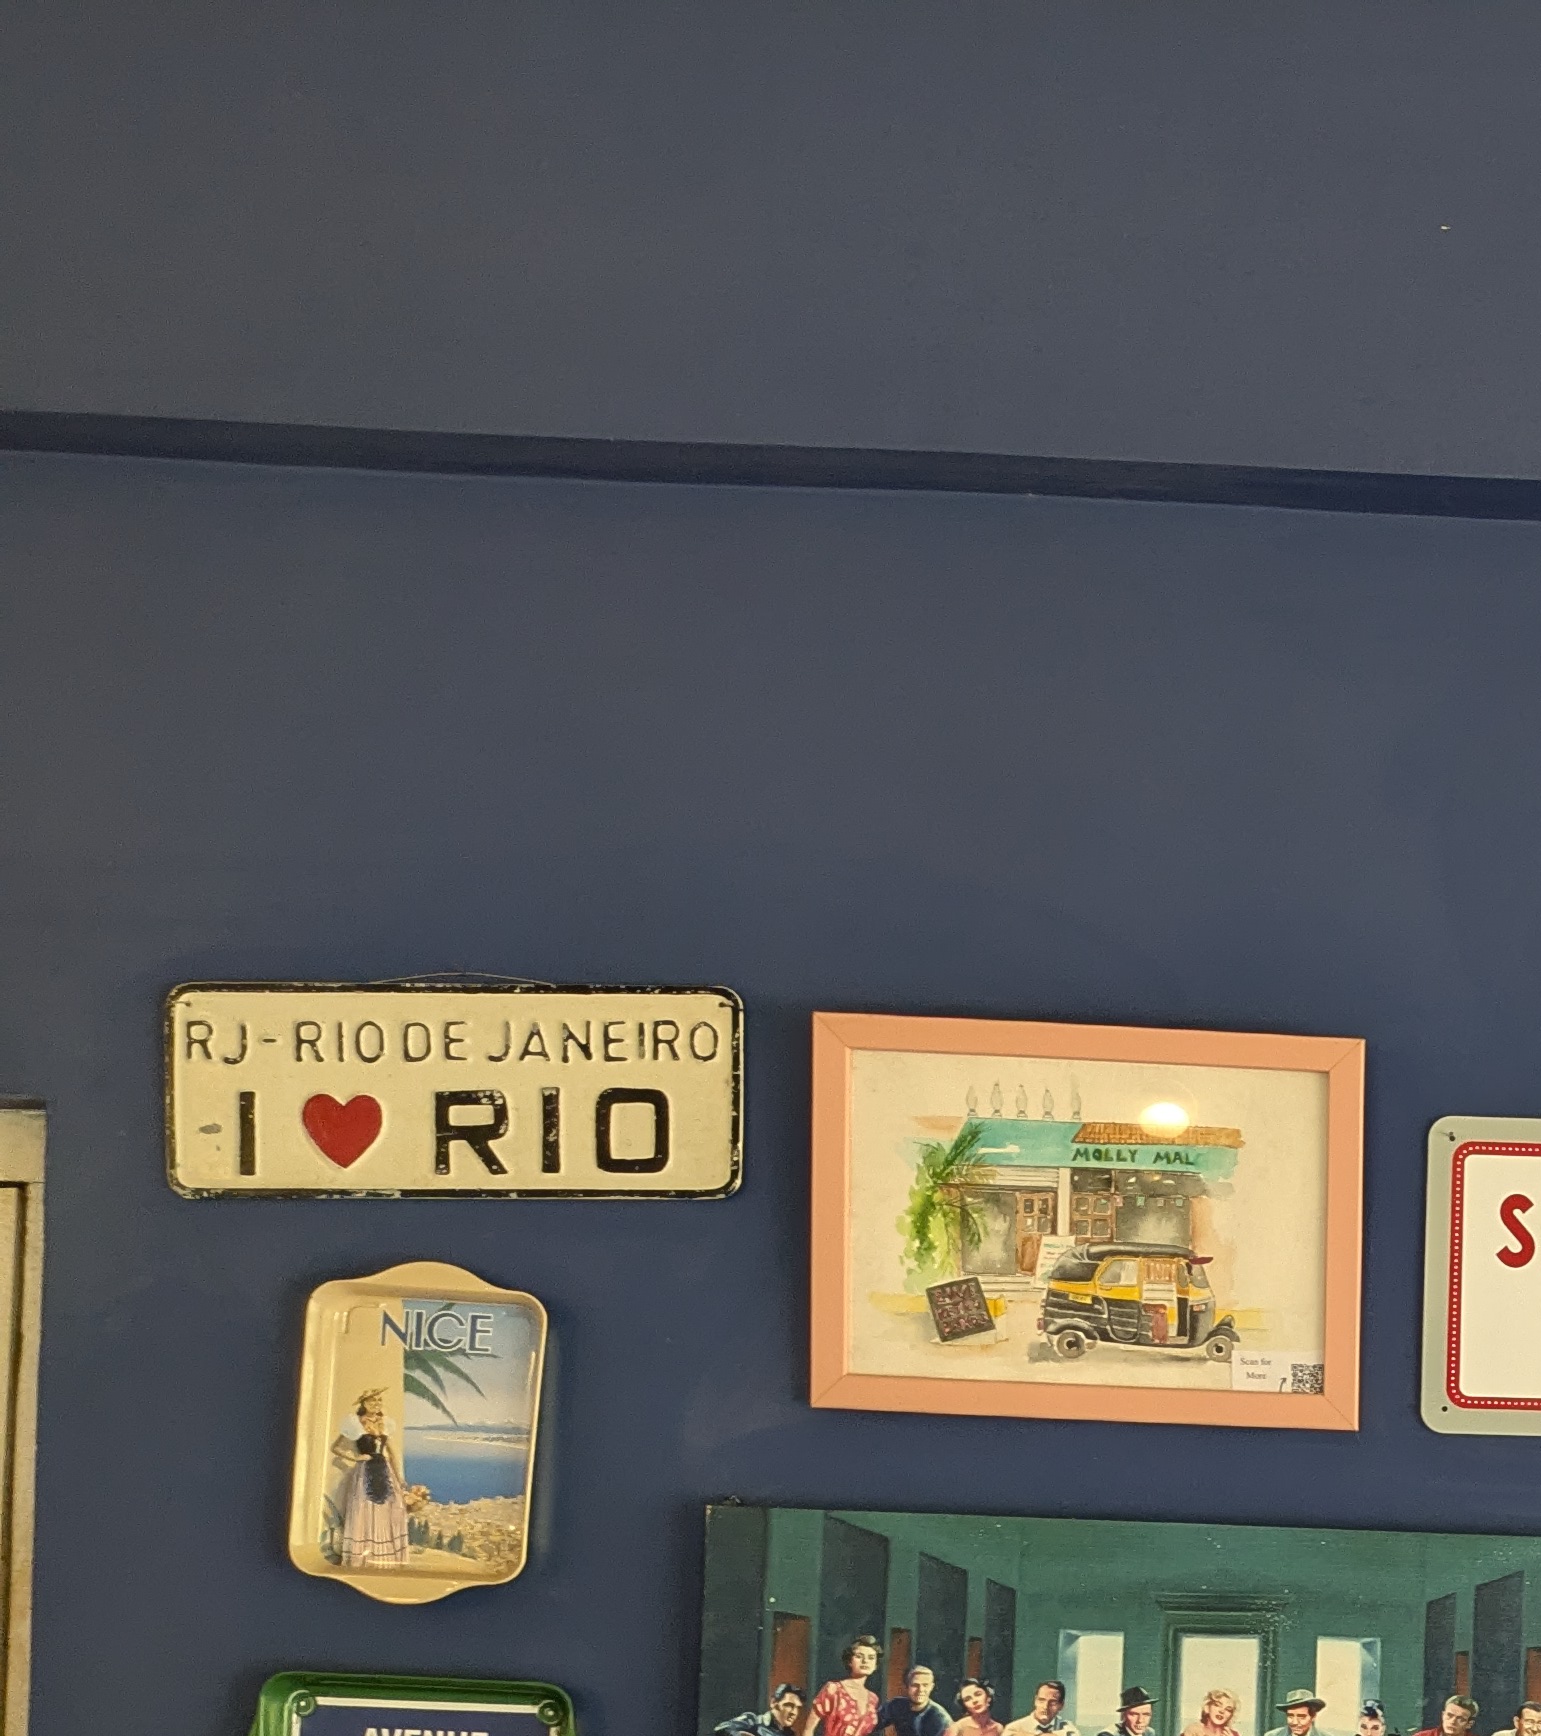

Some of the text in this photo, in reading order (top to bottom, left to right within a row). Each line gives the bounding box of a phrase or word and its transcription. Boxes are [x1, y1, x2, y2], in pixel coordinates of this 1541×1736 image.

[402, 1021, 469, 1062] DE
[488, 1019, 720, 1063] JANEIRO
[238, 1086, 671, 1176] I RIO
[1071, 1146, 1138, 1164] MOLLY
[379, 1307, 495, 1356] NICE
[1240, 1357, 1272, 1367] Scan for
